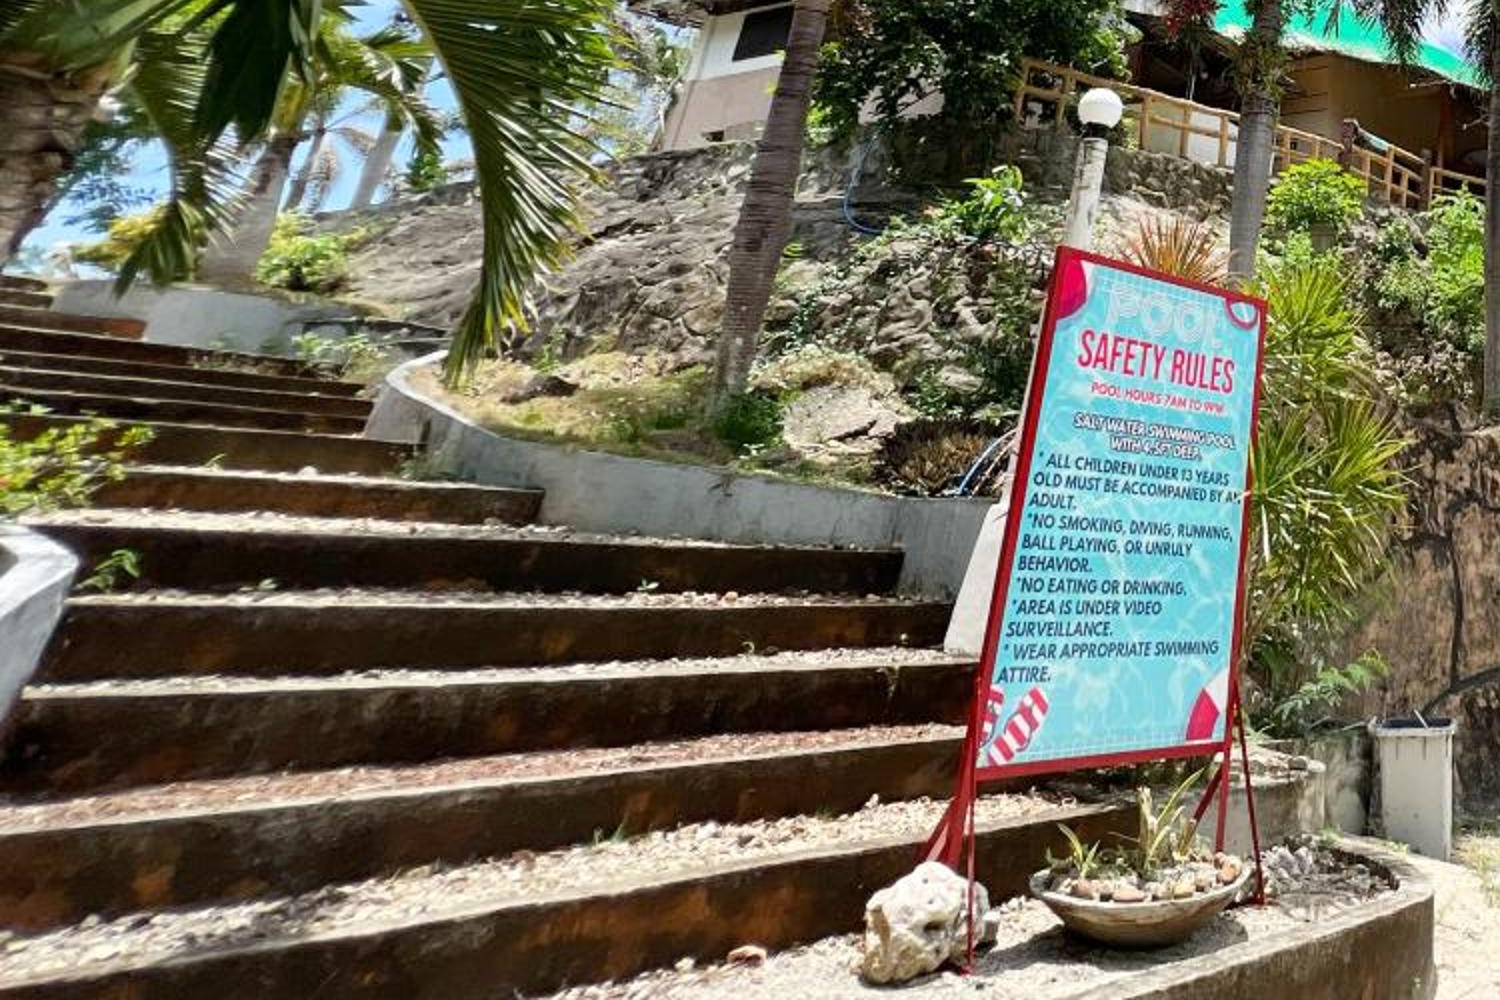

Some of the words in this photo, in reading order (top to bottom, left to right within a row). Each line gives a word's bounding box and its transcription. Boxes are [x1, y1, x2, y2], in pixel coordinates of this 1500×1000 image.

[1107, 283, 1222, 348] POOL
[1078, 329, 1166, 379] SAFETY
[1170, 349, 1235, 394] RULES
[1091, 382, 1120, 398] POOL
[1188, 399, 1201, 411] TO
[1073, 411, 1105, 430] SALT
[1105, 418, 1145, 436] WATER
[1148, 424, 1206, 444] SWIMMING
[1205, 431, 1235, 450] POOL
[1110, 435, 1142, 453] WITH
[1046, 453, 1071, 468] ALL
[1074, 456, 1136, 475] CHILDREN
[1139, 464, 1179, 481] UNDER
[1181, 468, 1193, 482] 13
[1195, 470, 1230, 486] YEARS
[1033, 471, 1062, 487] OLD
[1065, 474, 1101, 491] MUST
[1103, 479, 1119, 493] BE
[1121, 480, 1207, 502] ACCOMPANIED
[1209, 490, 1224, 503] BY
[1030, 493, 1077, 511] ADULT.
[1058, 516, 1125, 536] SMOKING,
[1177, 523, 1233, 543] RUNNING,
[1022, 534, 1057, 550] BALL
[1124, 540, 1143, 555] OR
[1145, 541, 1193, 557] UNRULY
[1018, 555, 1093, 573] BEHAVIOR.
[1047, 577, 1098, 594] EATING
[1101, 579, 1120, 595] OR
[1059, 600, 1072, 615] IS
[1075, 600, 1121, 616] UNDER
[1124, 601, 1163, 616] VIDEO
[1013, 644, 1056, 660] WEAR
[1060, 642, 1152, 659] APPROPRIATE
[1154, 640, 1220, 655] SWIMMING
[999, 666, 1051, 683] ATTIRE.
